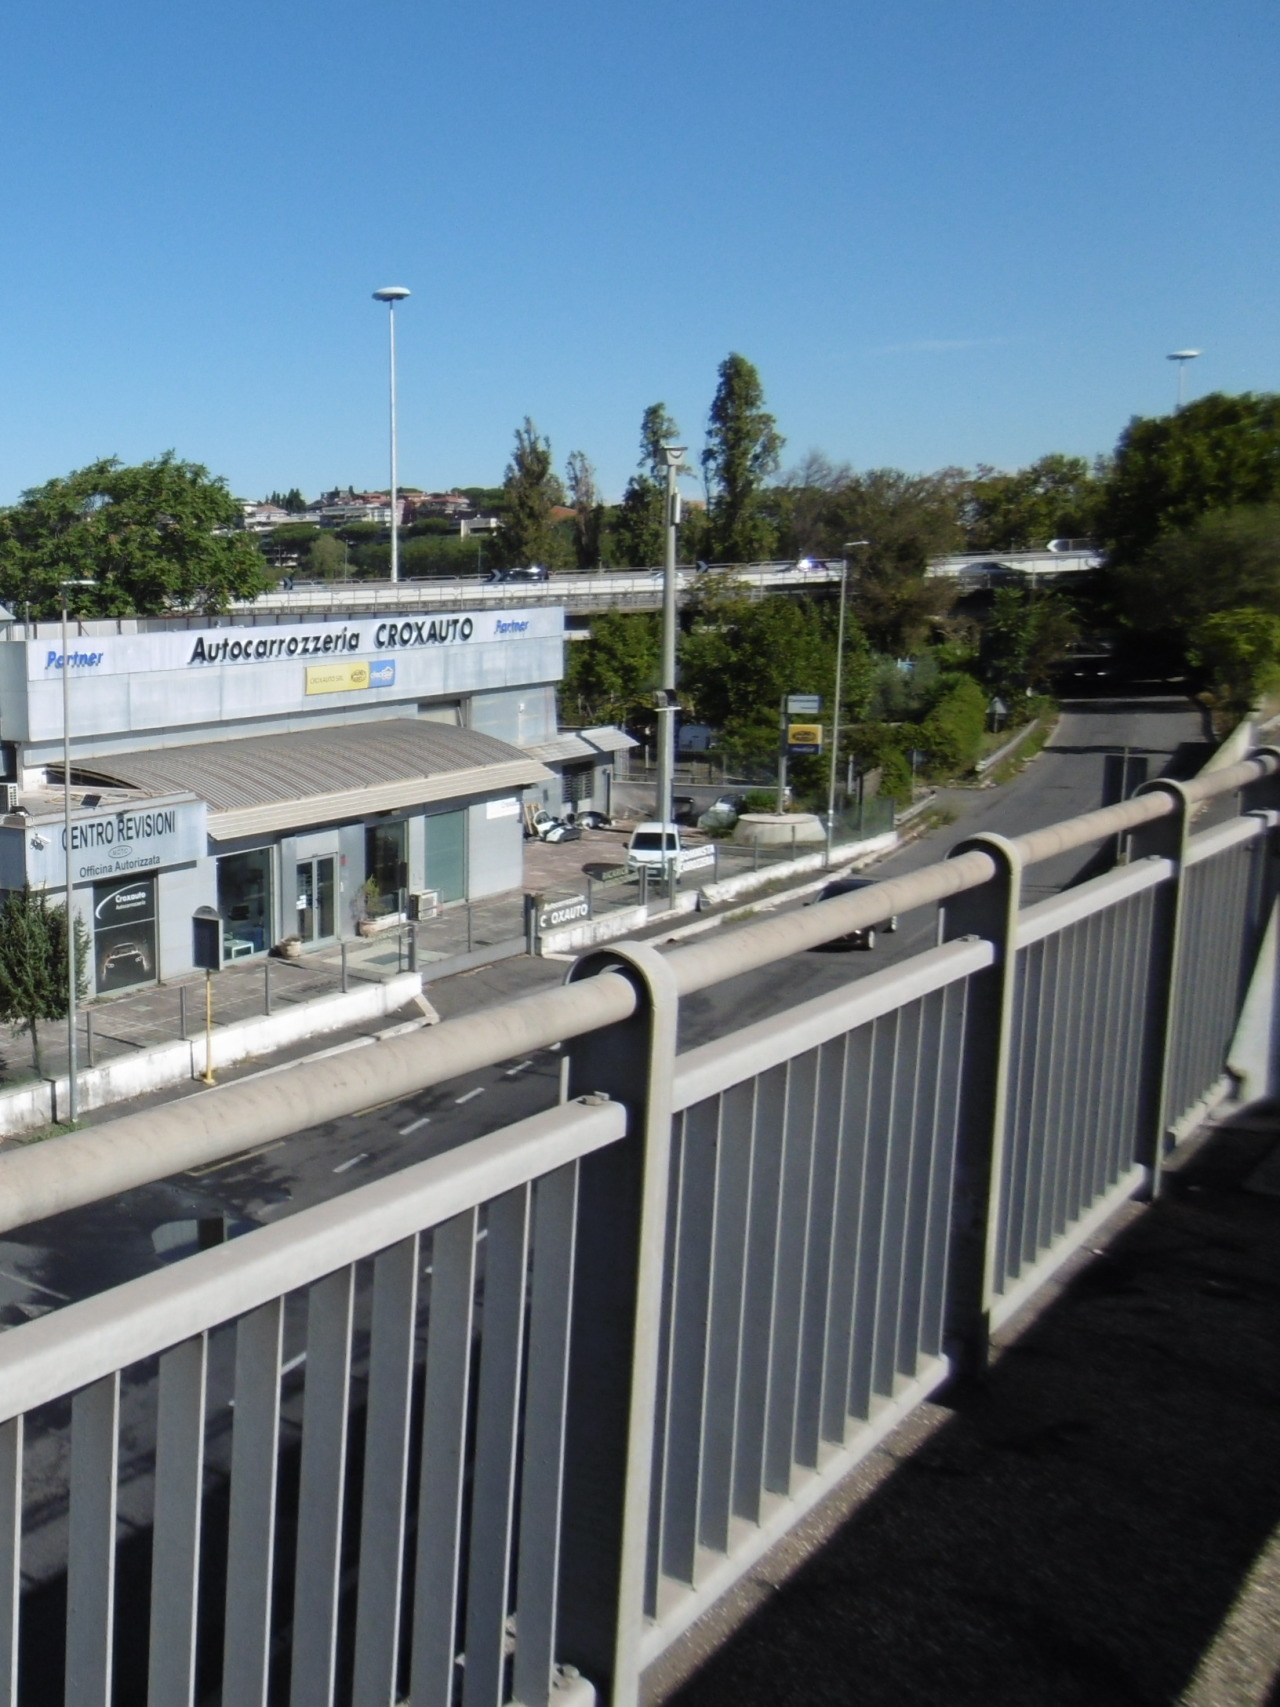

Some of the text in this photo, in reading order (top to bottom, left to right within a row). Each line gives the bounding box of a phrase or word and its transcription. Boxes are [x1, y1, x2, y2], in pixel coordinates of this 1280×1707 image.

[495, 619, 530, 634] Partner
[189, 617, 474, 664] Autocarrozzeria CROXAUTO
[45, 650, 104, 670] Partner
[117, 811, 176, 842] REVISIONI
[80, 855, 161, 878] Officina Autorizzata
[115, 892, 146, 903] Croxauto
[540, 904, 588, 928] COXAUTO
